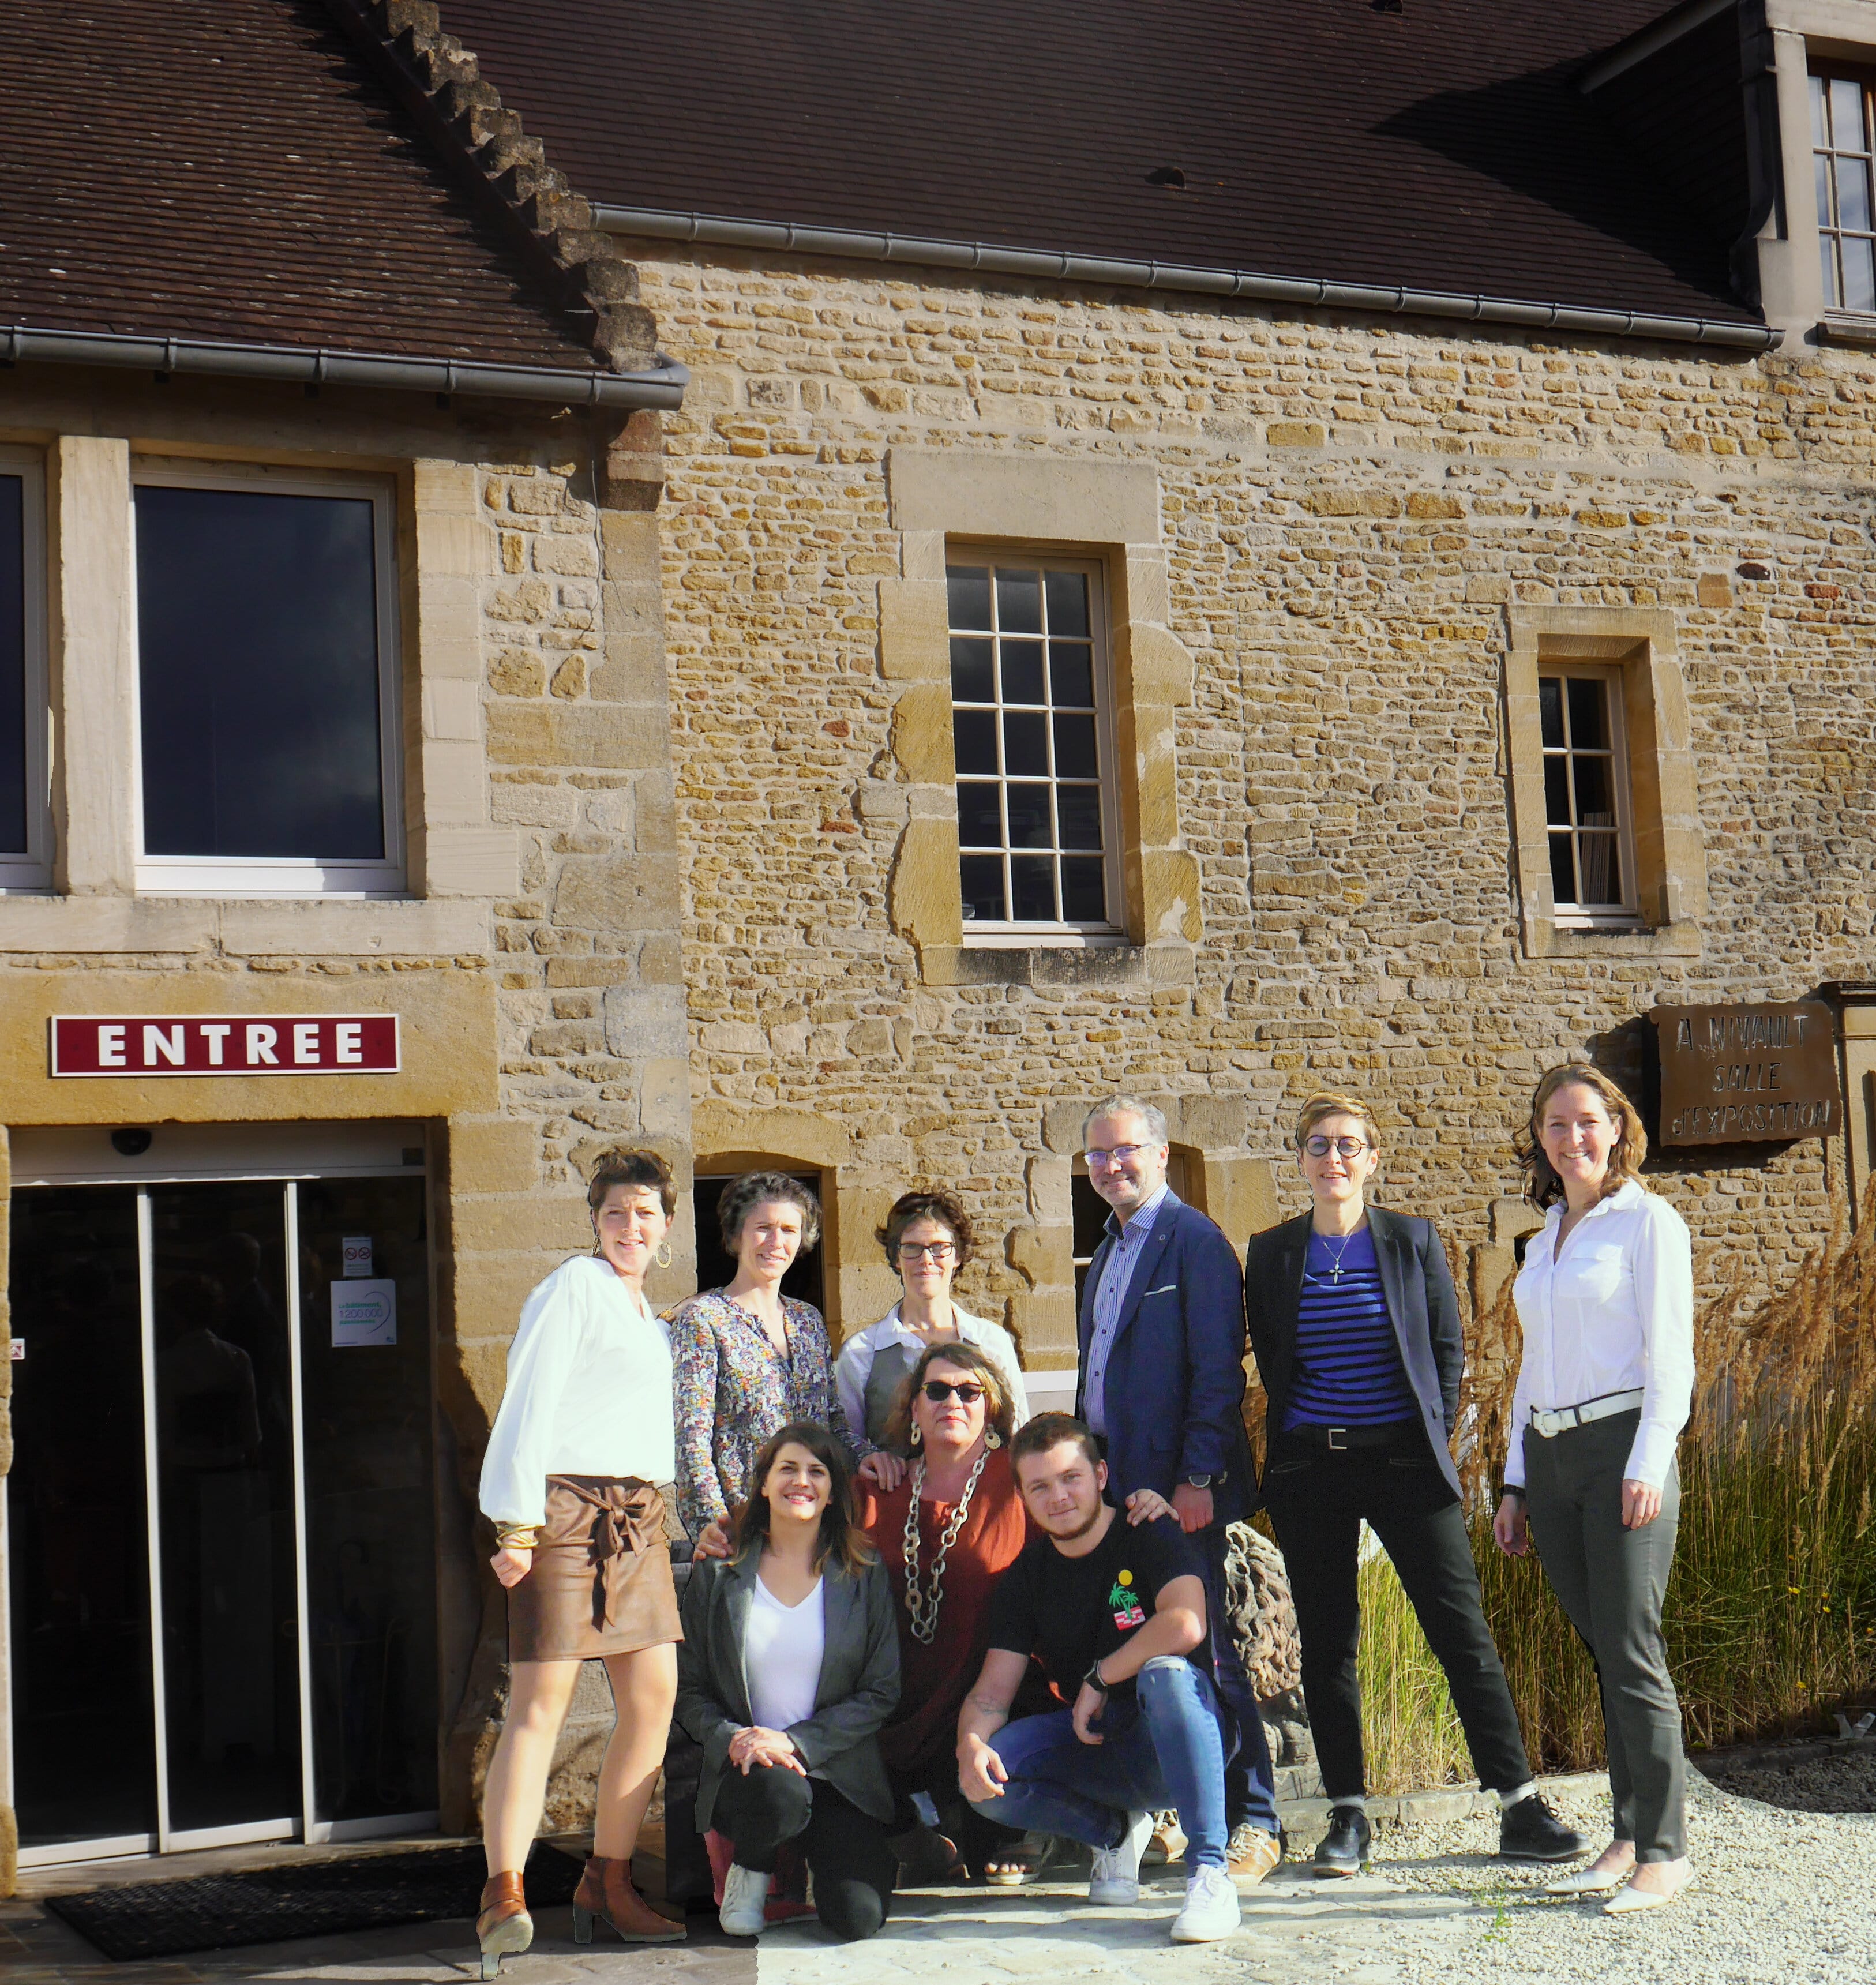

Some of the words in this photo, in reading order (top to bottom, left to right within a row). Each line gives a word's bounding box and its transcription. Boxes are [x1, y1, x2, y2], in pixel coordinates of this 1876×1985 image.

[98, 1023, 363, 1067] ENTREE
[1676, 1017, 1693, 1052] A
[1709, 1014, 1809, 1051] NIVAULT
[1712, 1063, 1782, 1092] SALLE
[1672, 1100, 1831, 1135] d'EXPOSITION
